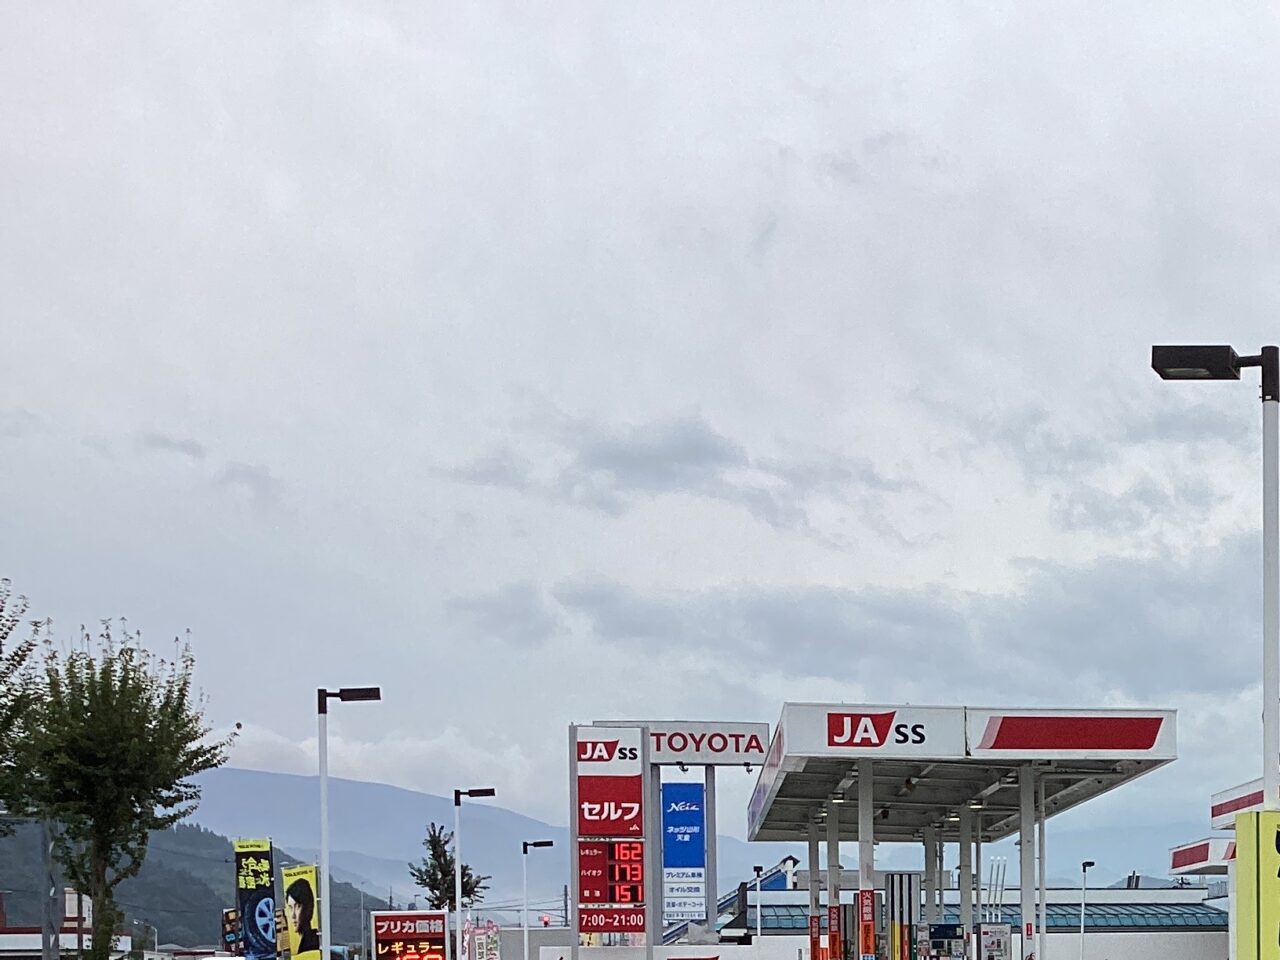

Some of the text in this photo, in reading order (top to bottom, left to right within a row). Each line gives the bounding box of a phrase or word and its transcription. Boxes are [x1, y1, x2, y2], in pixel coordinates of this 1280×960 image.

[833, 716, 879, 744] JA
[580, 742, 609, 760] JA
[650, 732, 765, 753] TOYOTA
[581, 801, 640, 821] セルフ
[615, 843, 642, 860] 162
[615, 864, 642, 881] 173
[615, 885, 642, 902] 151
[376, 920, 444, 934] プリカ価格
[378, 942, 443, 954] レギュラー
